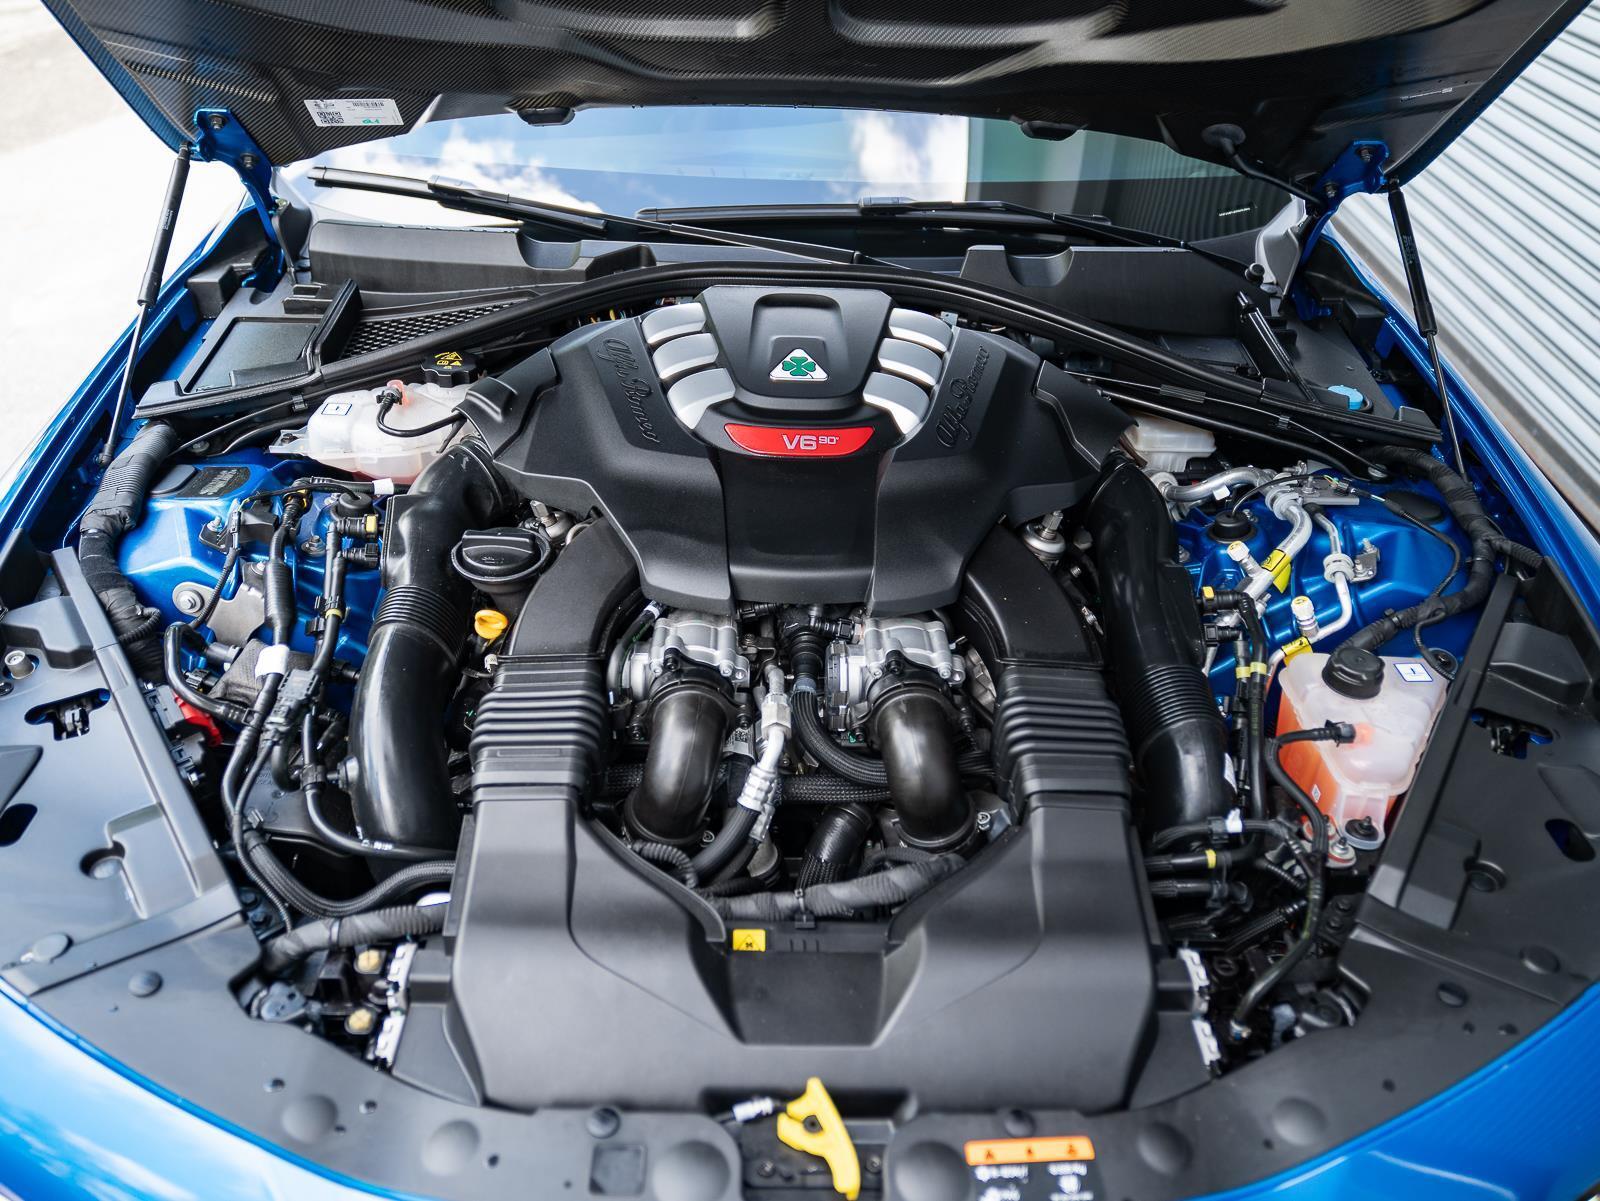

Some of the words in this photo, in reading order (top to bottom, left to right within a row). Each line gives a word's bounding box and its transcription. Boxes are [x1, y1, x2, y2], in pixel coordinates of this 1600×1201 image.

[596, 338, 639, 379] Alfa
[620, 378, 660, 443] Romeo
[782, 434, 817, 450] V6
